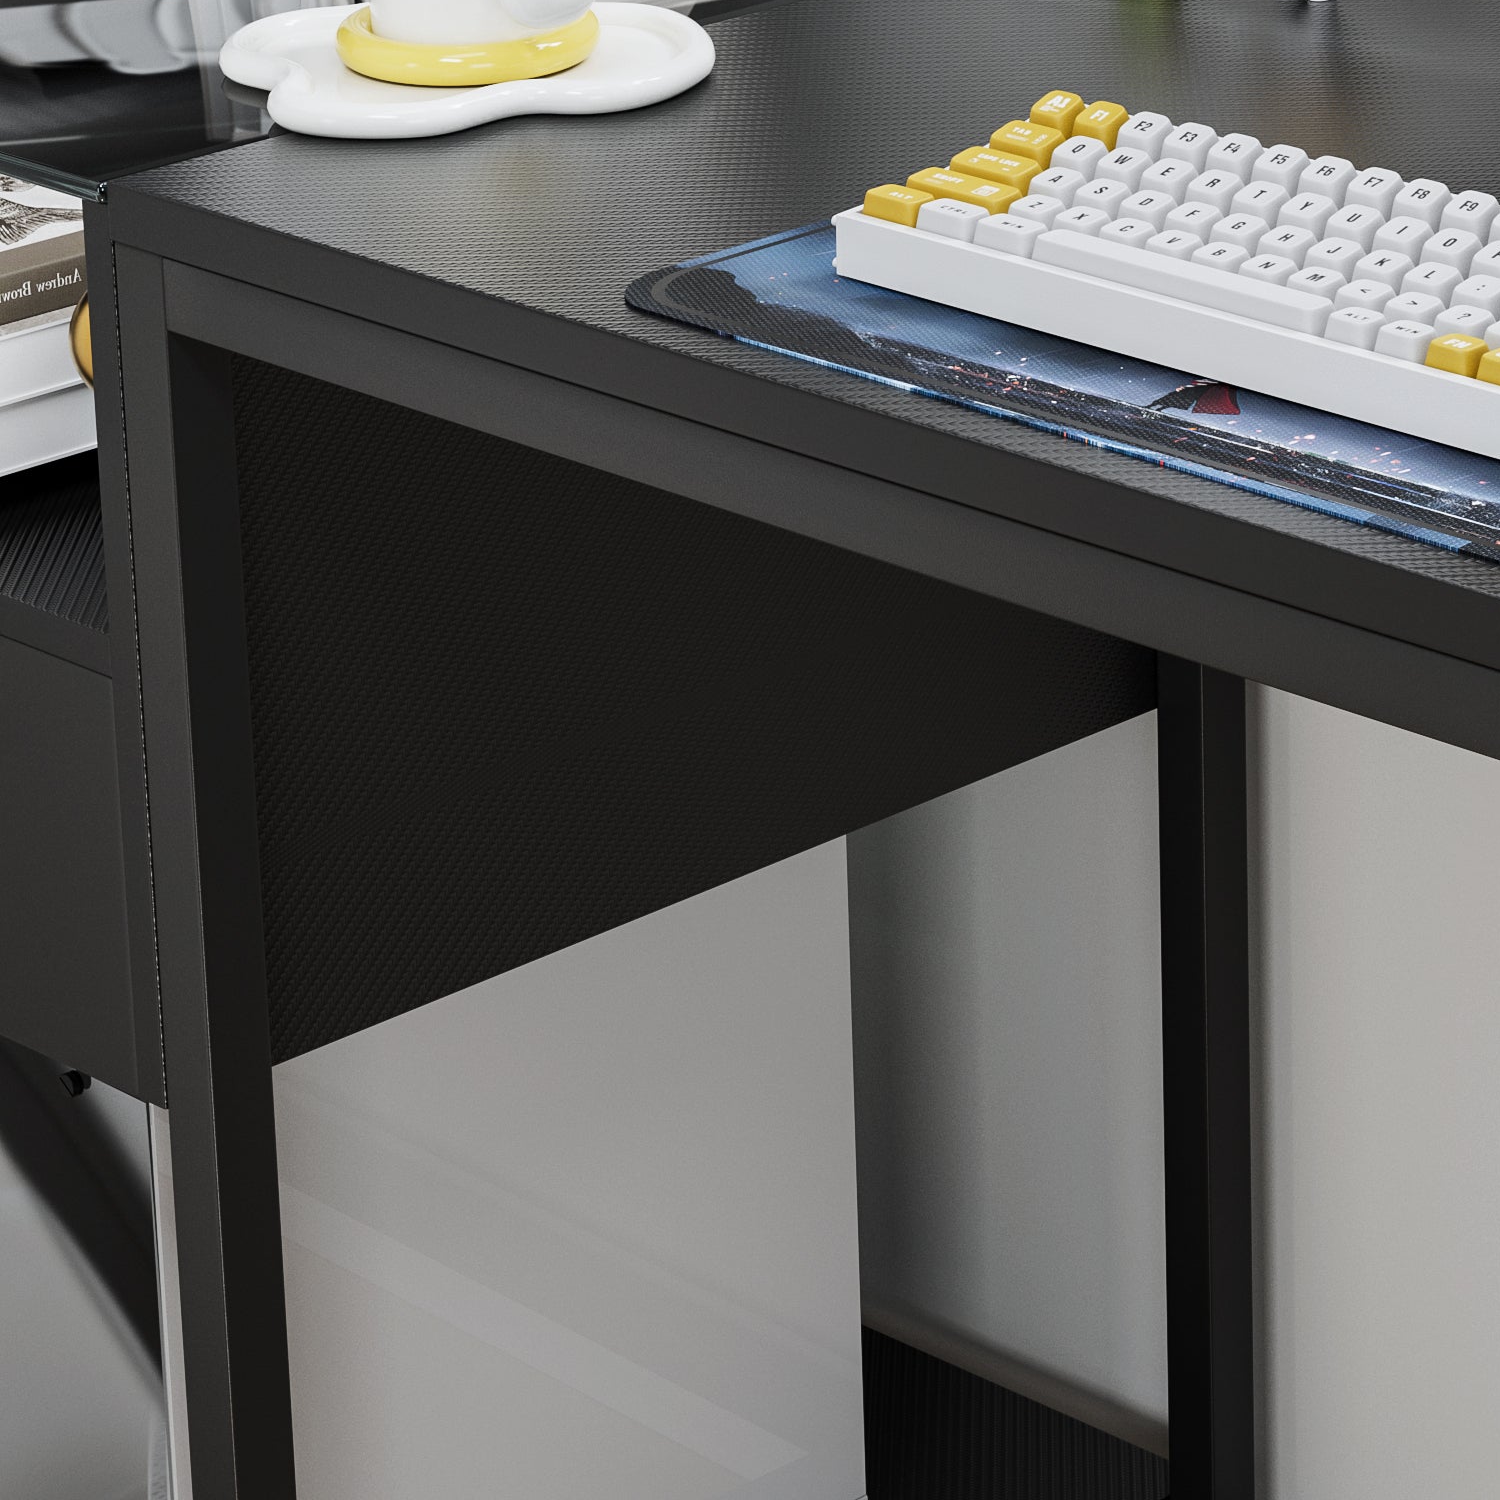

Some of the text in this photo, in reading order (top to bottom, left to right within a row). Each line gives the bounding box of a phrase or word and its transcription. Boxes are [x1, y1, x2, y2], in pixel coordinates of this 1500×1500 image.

[1089, 109, 1110, 122] F1
[1133, 120, 1153, 132] F2
[1178, 131, 1198, 142] F3
[1071, 144, 1086, 153] Q
[1222, 142, 1241, 154] F4
[1113, 154, 1133, 165] W
[1270, 153, 1290, 165] F5
[1160, 166, 1175, 176] E
[1316, 165, 1336, 177] F6
[1048, 175, 1063, 183] A
[1205, 178, 1221, 188] R
[1363, 176, 1384, 188] F7
[1093, 186, 1109, 195] S
[1252, 190, 1267, 199] T
[1410, 188, 1431, 200] F8
[1138, 197, 1154, 206] D
[1299, 201, 1314, 211] Y
[1458, 200, 1479, 212] F9
[1072, 212, 1089, 220] X
[1185, 209, 1201, 218] F
[1346, 213, 1363, 223] U
[1119, 224, 1134, 232] C
[1231, 221, 1247, 230] G
[1277, 233, 1295, 242] H
[1442, 237, 1458, 247] O
[1210, 248, 1227, 256] B
[1326, 246, 1343, 254] J
[1258, 261, 1277, 269] N
[1374, 257, 1392, 267] K
[1305, 273, 1326, 282] M
[1423, 270, 1436, 279] L
